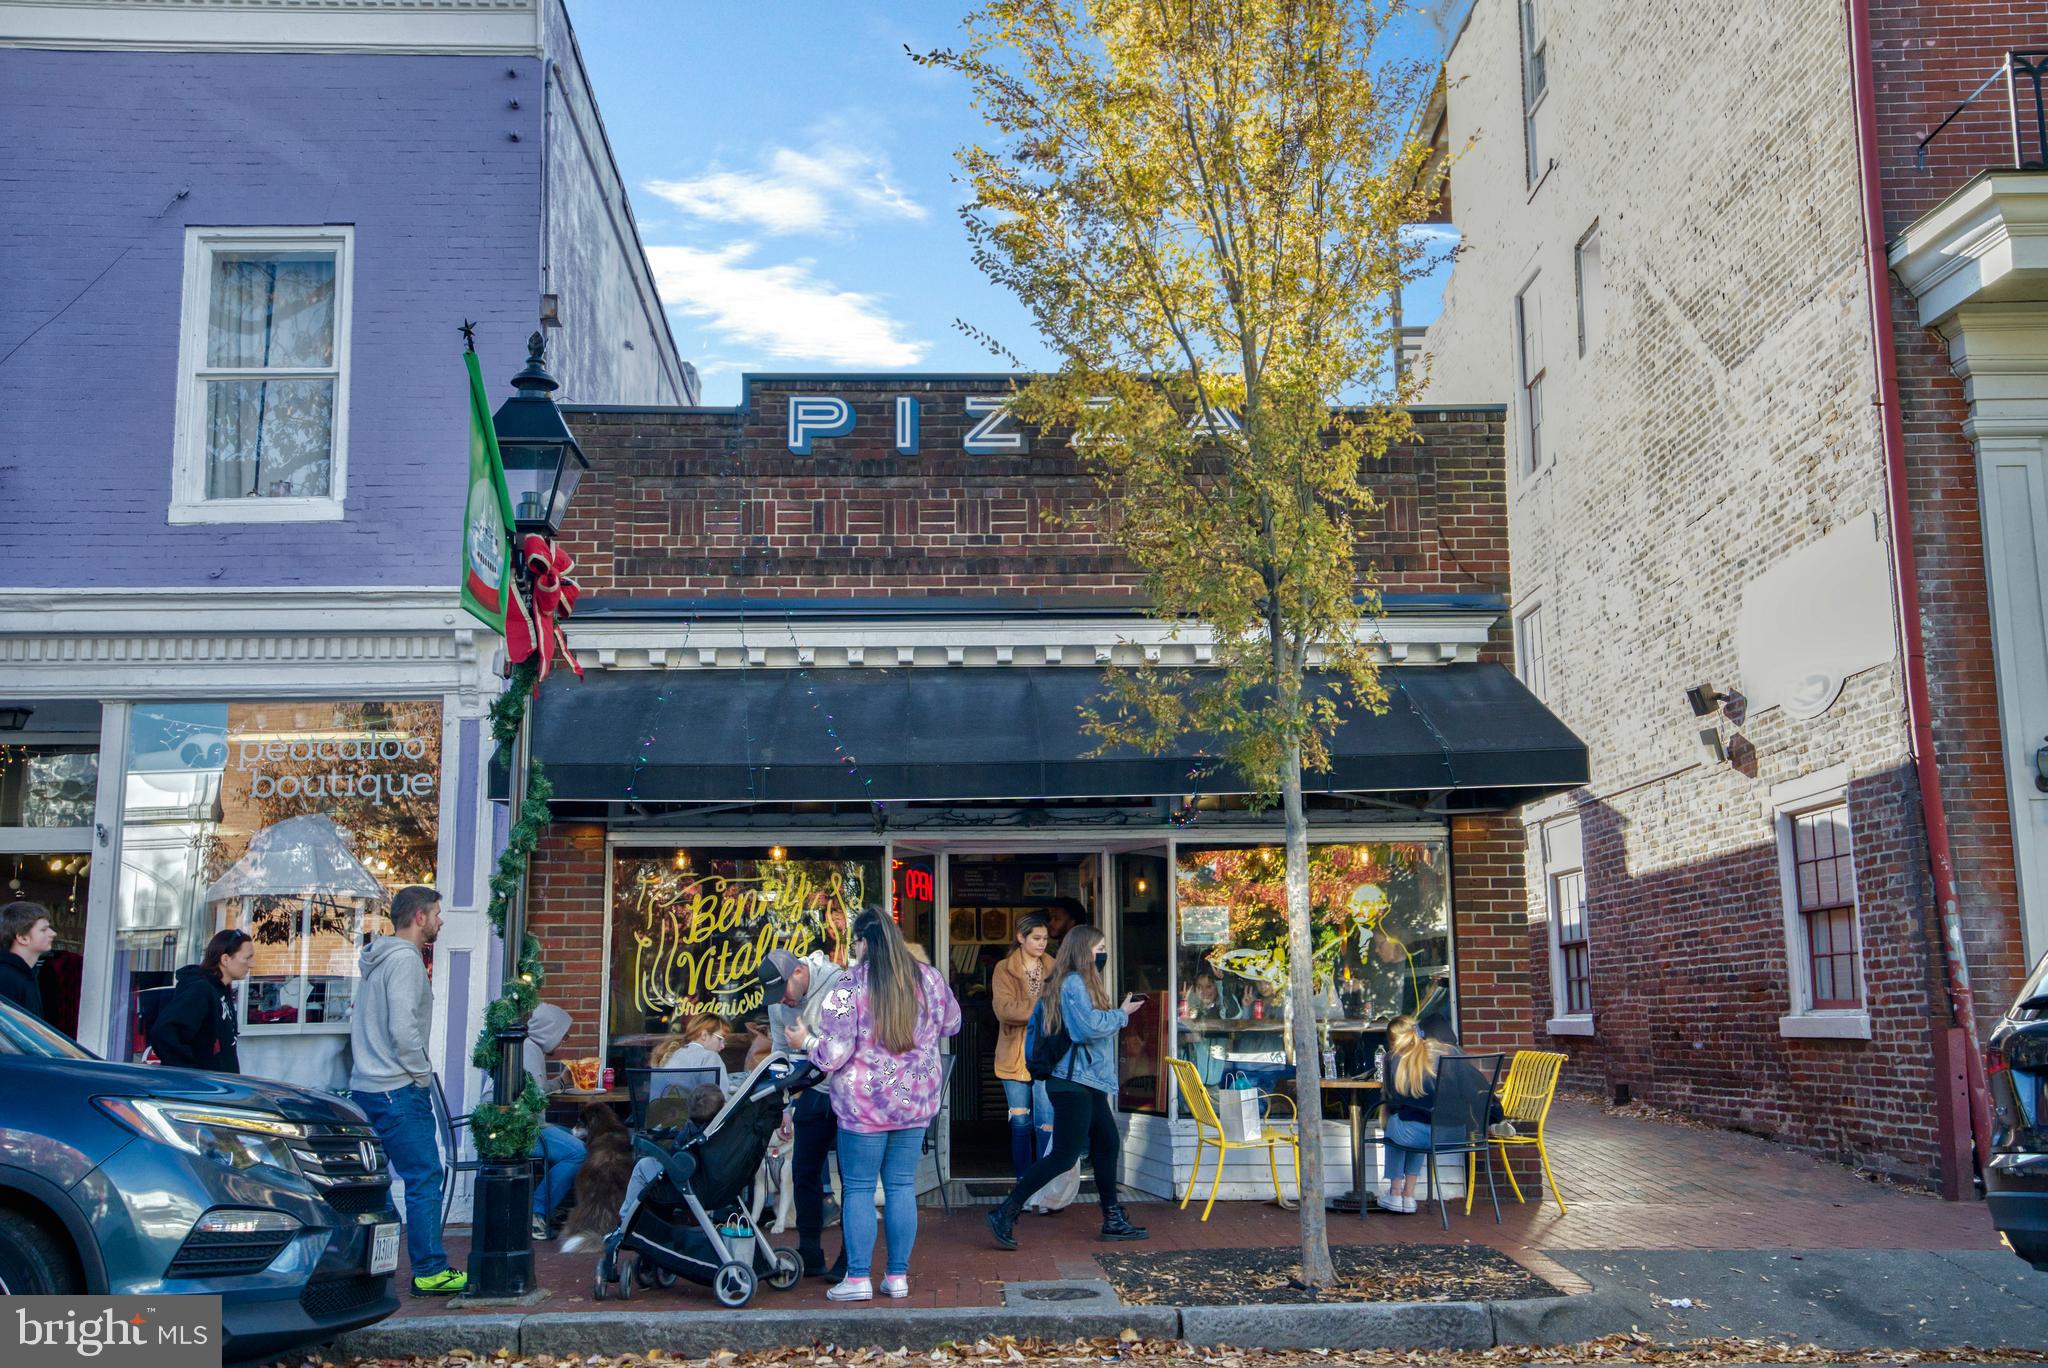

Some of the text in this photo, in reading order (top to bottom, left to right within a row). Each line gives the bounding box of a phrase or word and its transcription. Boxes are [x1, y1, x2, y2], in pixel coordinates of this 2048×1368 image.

[236, 730, 426, 772] peacaloo
[250, 766, 433, 806] boutique
[905, 868, 933, 904] OPEN
[683, 872, 812, 945] Benny
